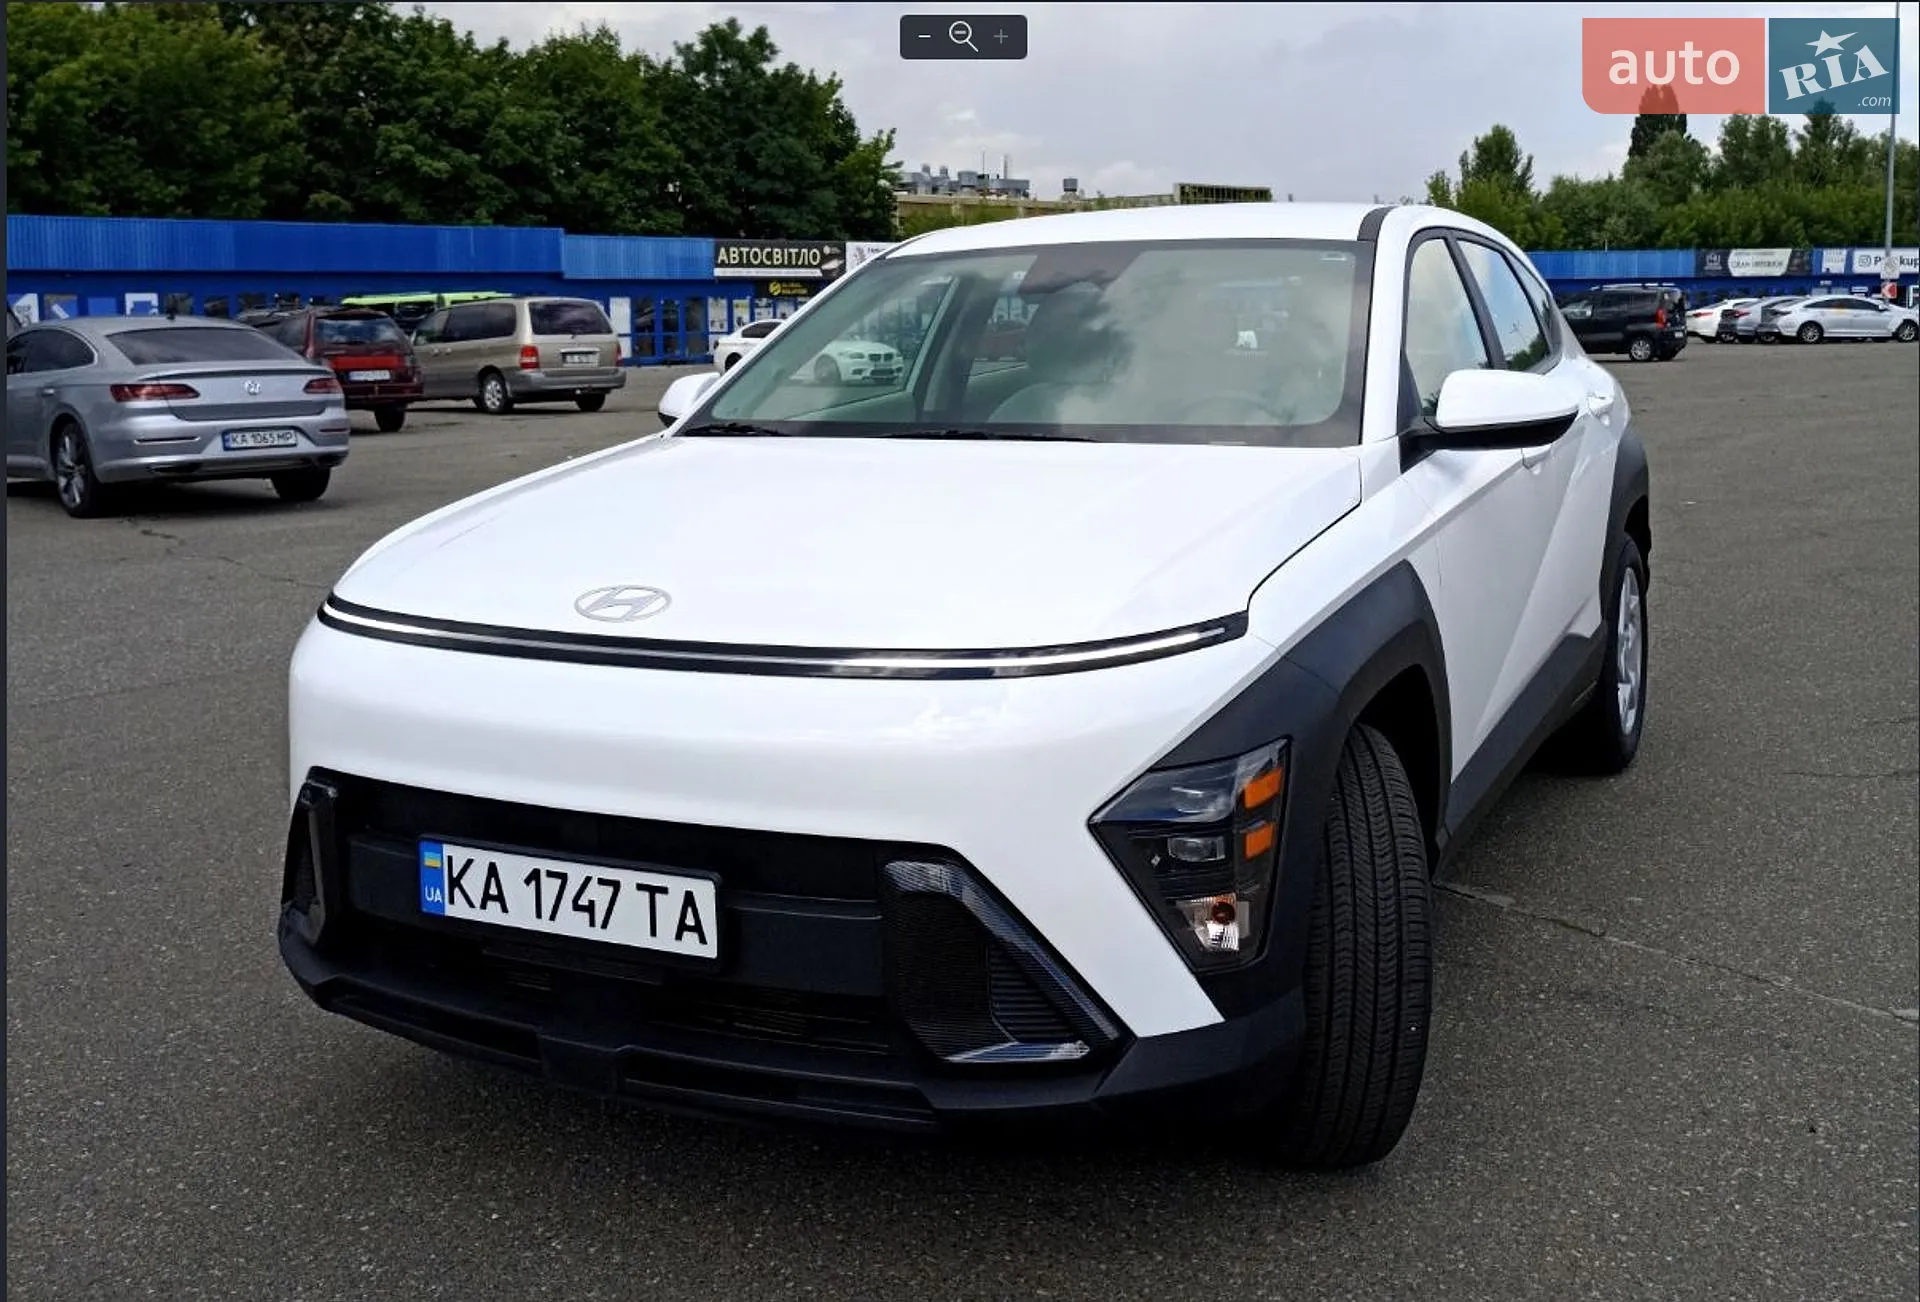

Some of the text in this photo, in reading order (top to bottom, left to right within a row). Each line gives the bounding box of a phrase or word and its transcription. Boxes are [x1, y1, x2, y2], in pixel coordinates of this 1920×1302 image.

[717, 246, 821, 266] АВТОСВІТЛО
[425, 885, 442, 902] UA
[447, 855, 708, 945] KA 1747 TA
